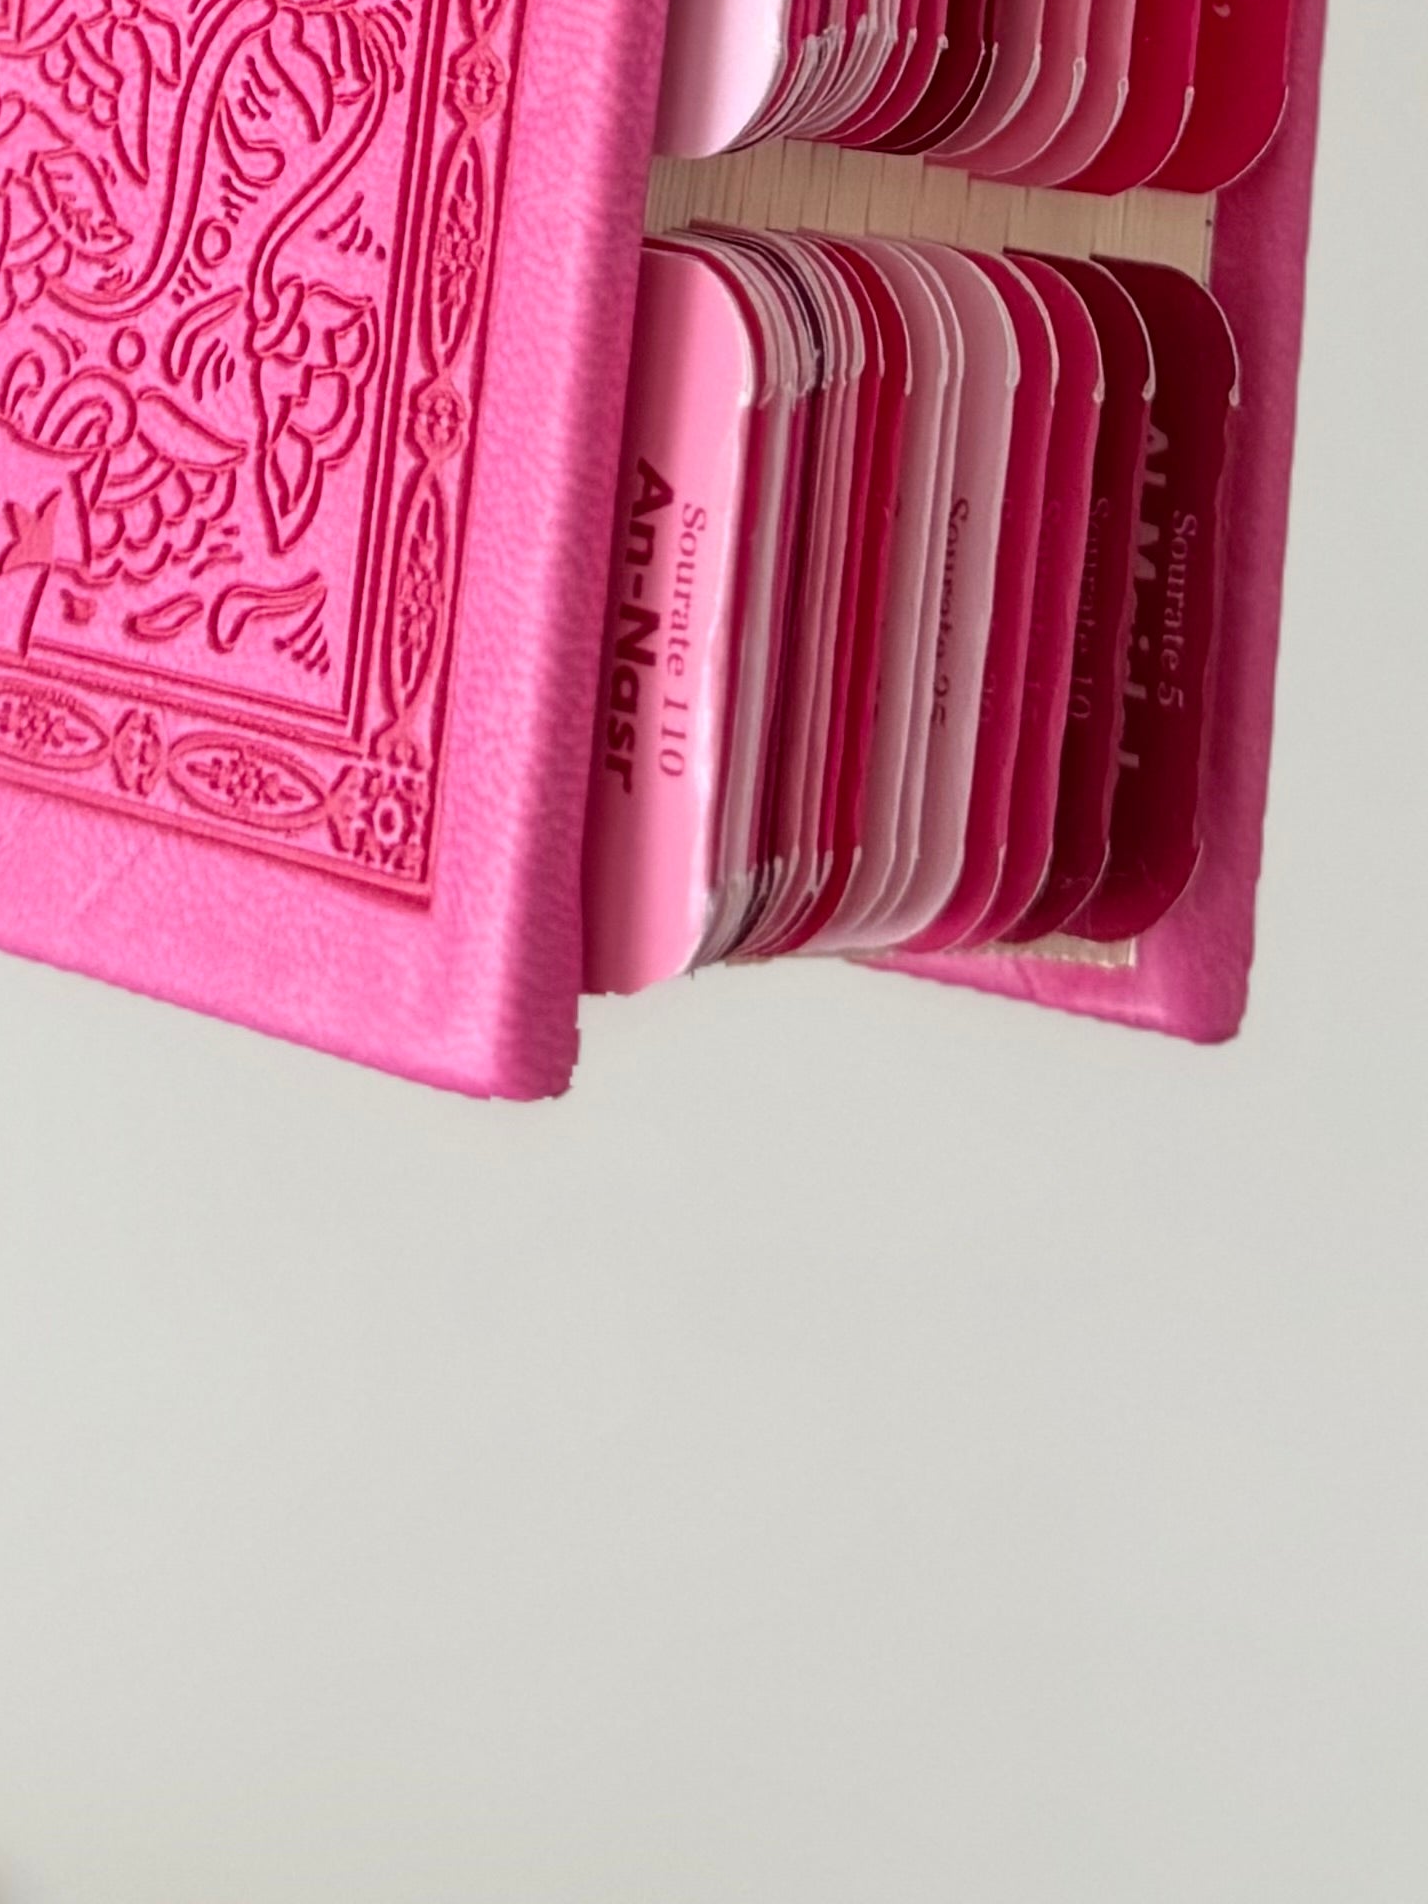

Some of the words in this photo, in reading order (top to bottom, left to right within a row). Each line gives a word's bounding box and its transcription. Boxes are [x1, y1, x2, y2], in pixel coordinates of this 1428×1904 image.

[604, 455, 675, 794] An-Nasr
[666, 502, 708, 678] Sourate
[1160, 508, 1197, 672] Sourate
[659, 696, 690, 778] 110
[1156, 681, 1185, 710] 5
